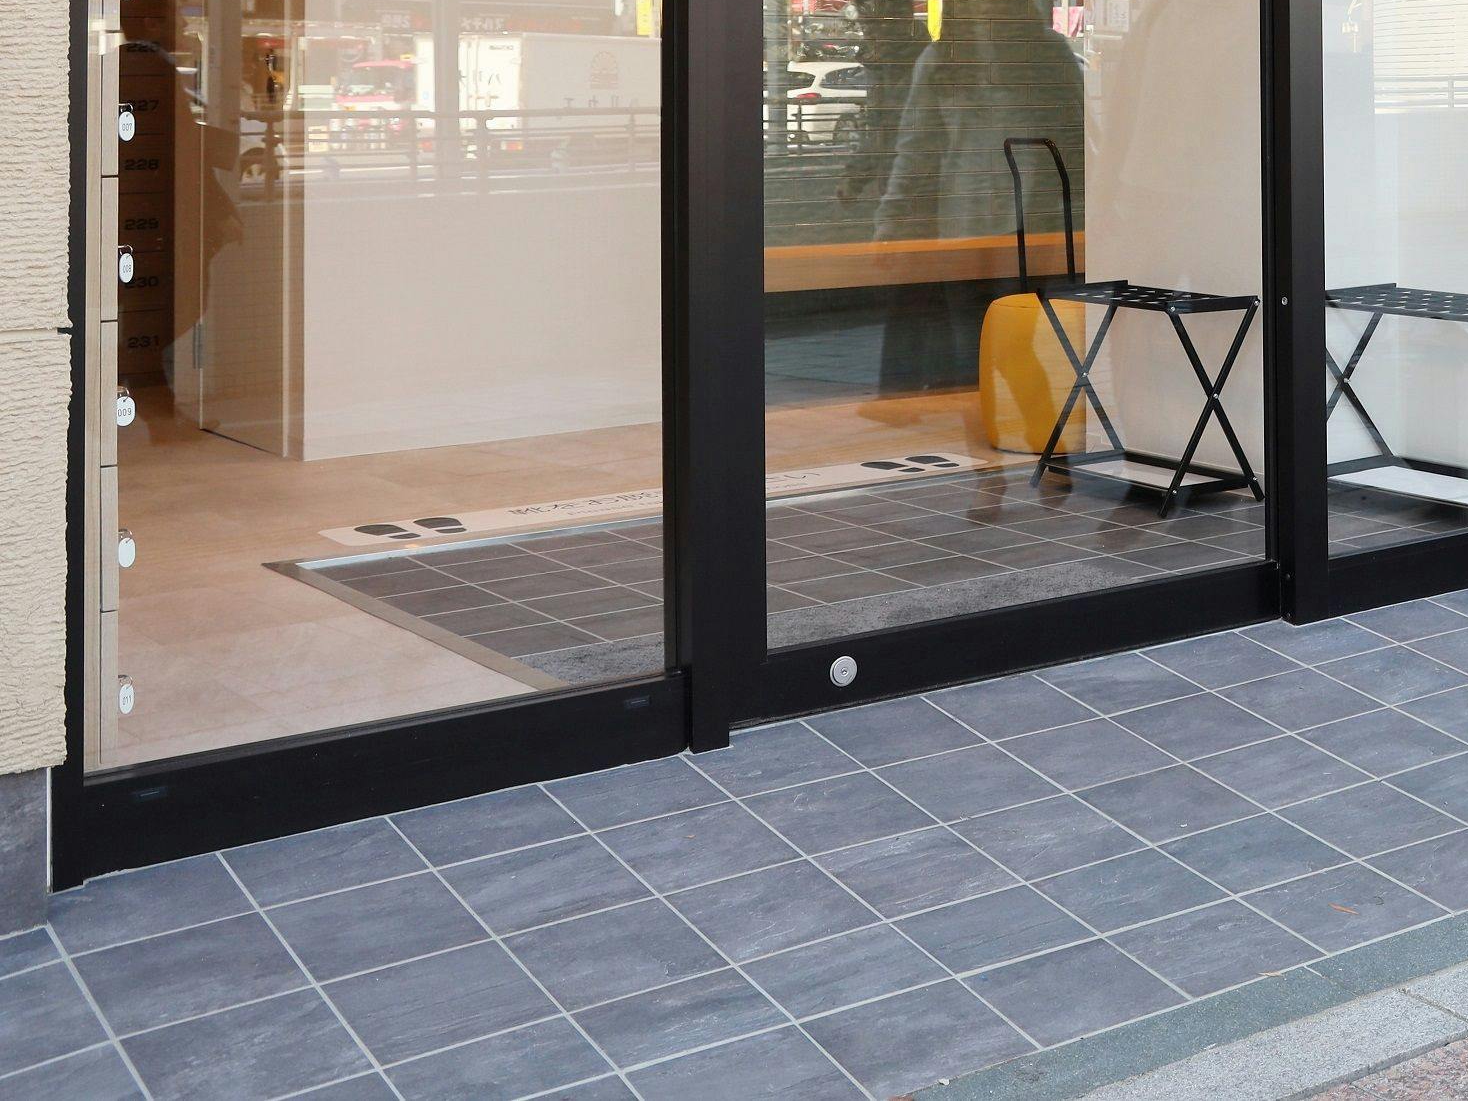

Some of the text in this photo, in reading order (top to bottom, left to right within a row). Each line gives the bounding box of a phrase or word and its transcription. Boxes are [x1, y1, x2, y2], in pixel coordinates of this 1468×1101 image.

[125, 158, 160, 171] 228
[125, 218, 160, 231] 229
[128, 336, 160, 349] 231
[117, 406, 133, 418] 009
